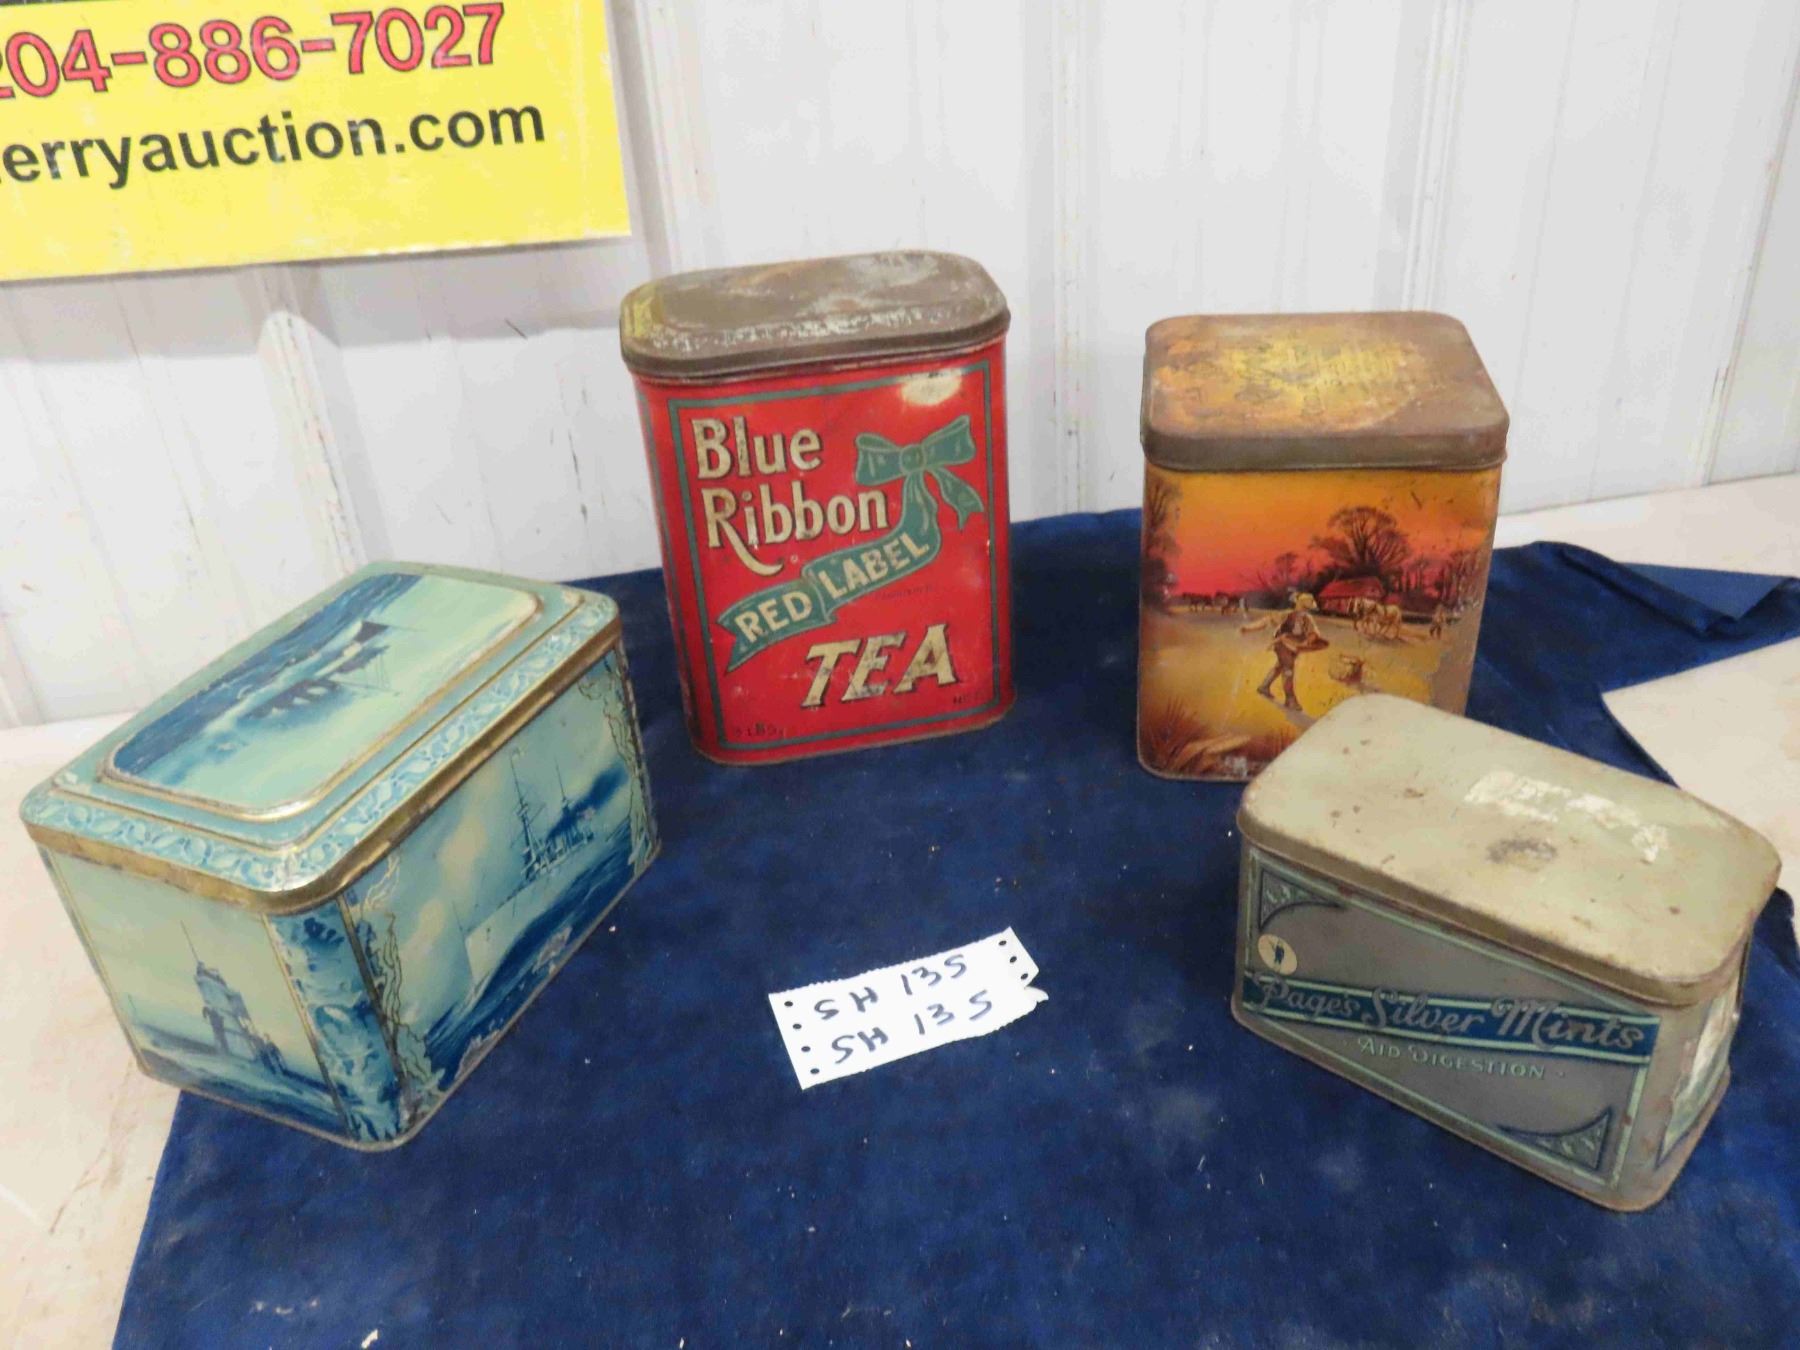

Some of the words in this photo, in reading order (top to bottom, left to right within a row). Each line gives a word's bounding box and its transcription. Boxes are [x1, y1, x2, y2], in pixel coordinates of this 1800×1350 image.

[0, 103, 546, 190] erryauction.com
[691, 415, 823, 480] Blue
[701, 480, 889, 577] Ribbon
[734, 590, 813, 643] RED
[818, 531, 930, 599] LABEL
[801, 623, 959, 711] TEA
[813, 986, 879, 1021] SH
[1361, 985, 1486, 1029] Silver
[1490, 997, 1646, 1051] Mints
[831, 1026, 889, 1064] SH
[1357, 1036, 1401, 1059] AID
[1407, 1044, 1547, 1080] DIGESTION
